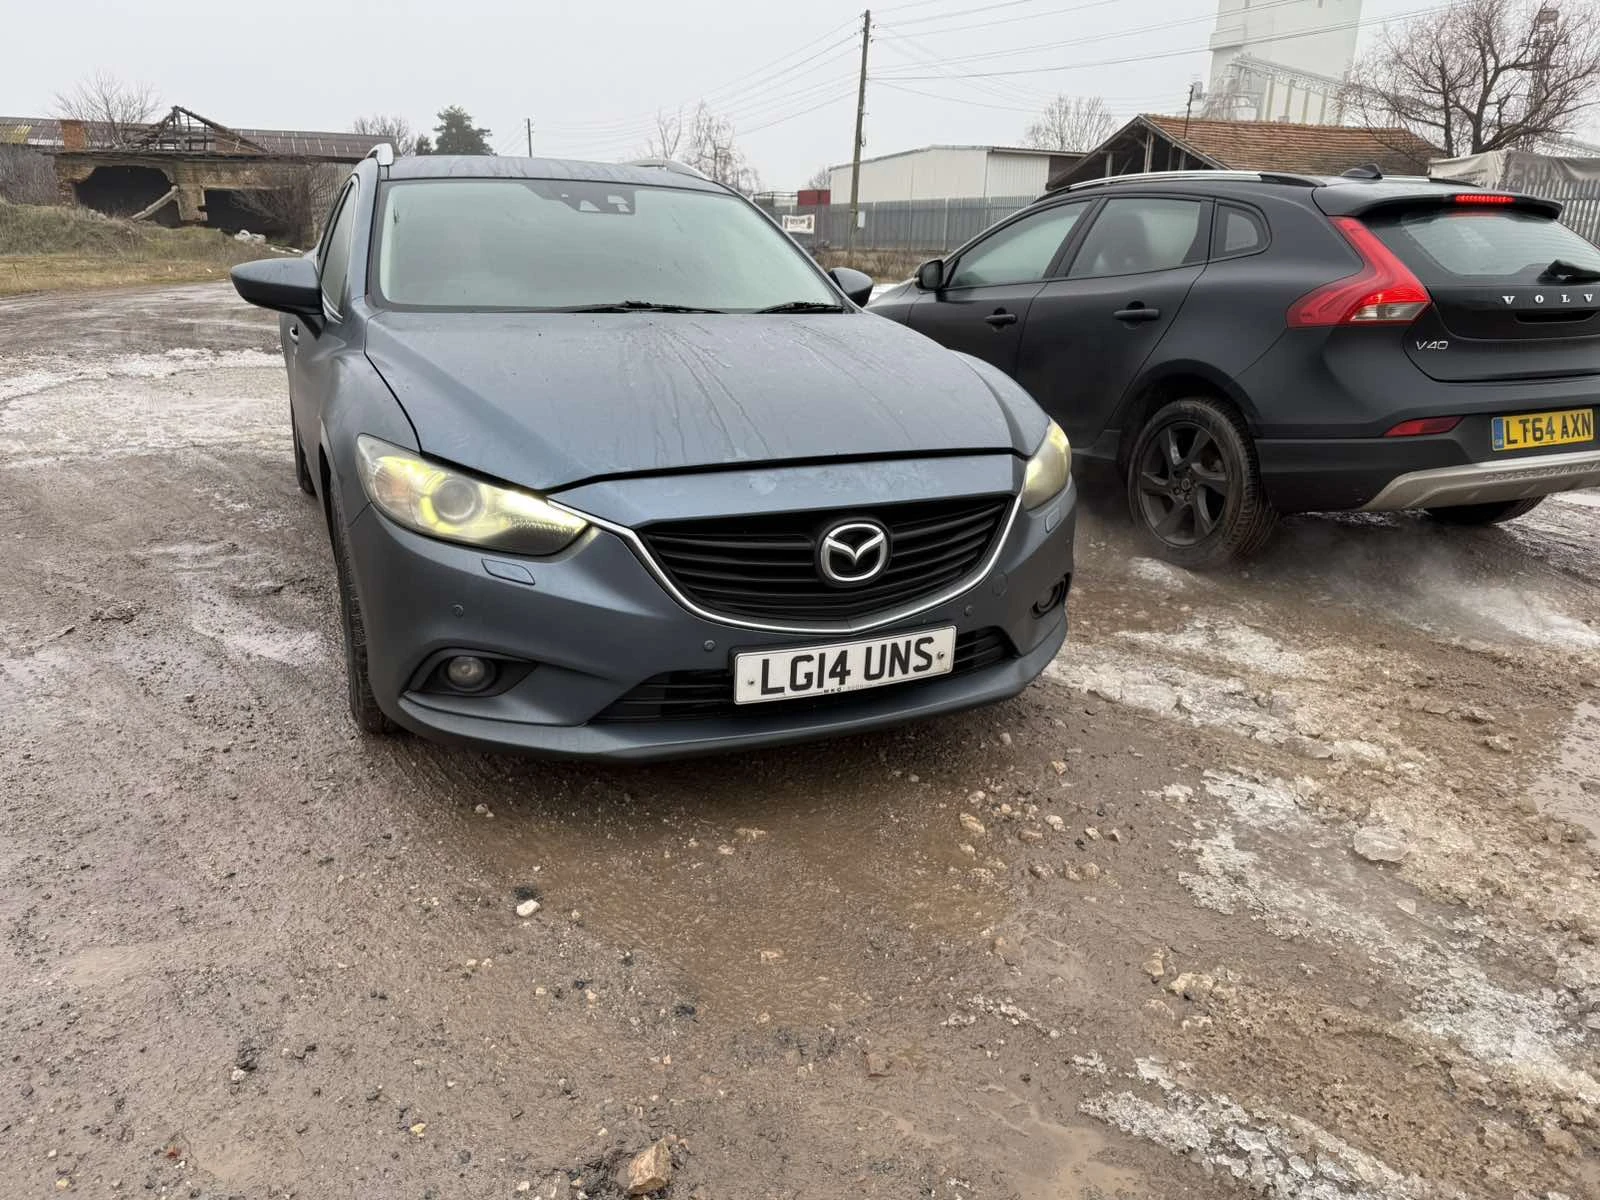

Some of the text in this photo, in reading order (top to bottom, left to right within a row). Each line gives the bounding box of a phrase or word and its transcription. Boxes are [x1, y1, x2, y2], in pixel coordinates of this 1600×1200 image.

[1415, 340, 1449, 351] V40
[1505, 412, 1591, 445] LT64 AXN
[760, 636, 935, 696] LG14 UNS
